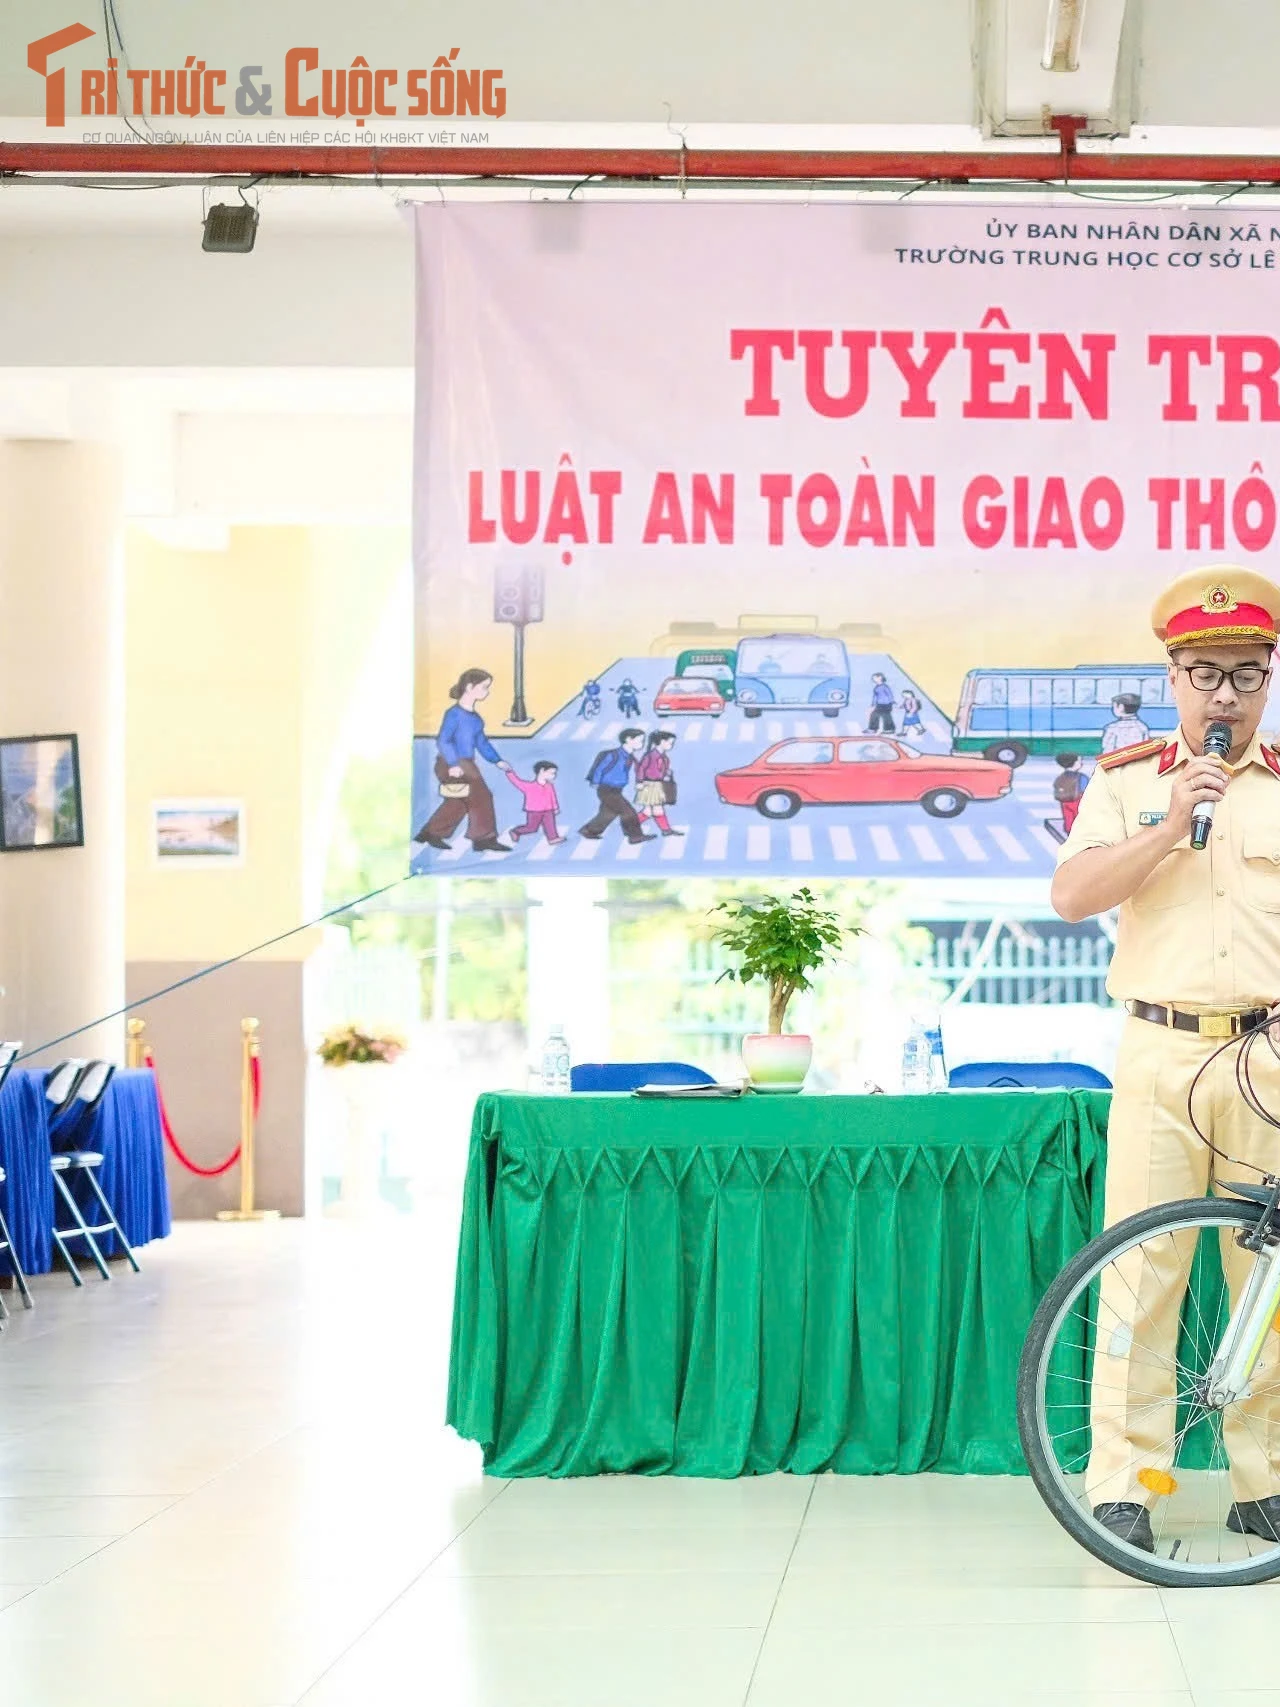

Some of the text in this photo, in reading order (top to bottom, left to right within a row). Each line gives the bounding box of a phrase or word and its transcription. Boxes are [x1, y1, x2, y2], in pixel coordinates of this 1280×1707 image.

[895, 244, 1005, 265] TRƯỜNG
[1012, 249, 1098, 266] TRUNG
[1107, 250, 1159, 271] HỌC
[1166, 250, 1203, 268] CƠ
[1209, 248, 1243, 269] SỞ
[1250, 248, 1275, 269] LÊ
[985, 217, 1019, 239] ỦY
[1026, 223, 1078, 239] BAN
[1086, 222, 1160, 241] NHÂN
[1168, 222, 1221, 241] DÂN
[1229, 222, 1262, 242] XÃ
[730, 307, 1116, 421] TUYÊN
[468, 453, 622, 566] LUẬT
[643, 472, 735, 545] AN
[760, 456, 936, 548] TOÀN
[963, 474, 1126, 551] GIAO
